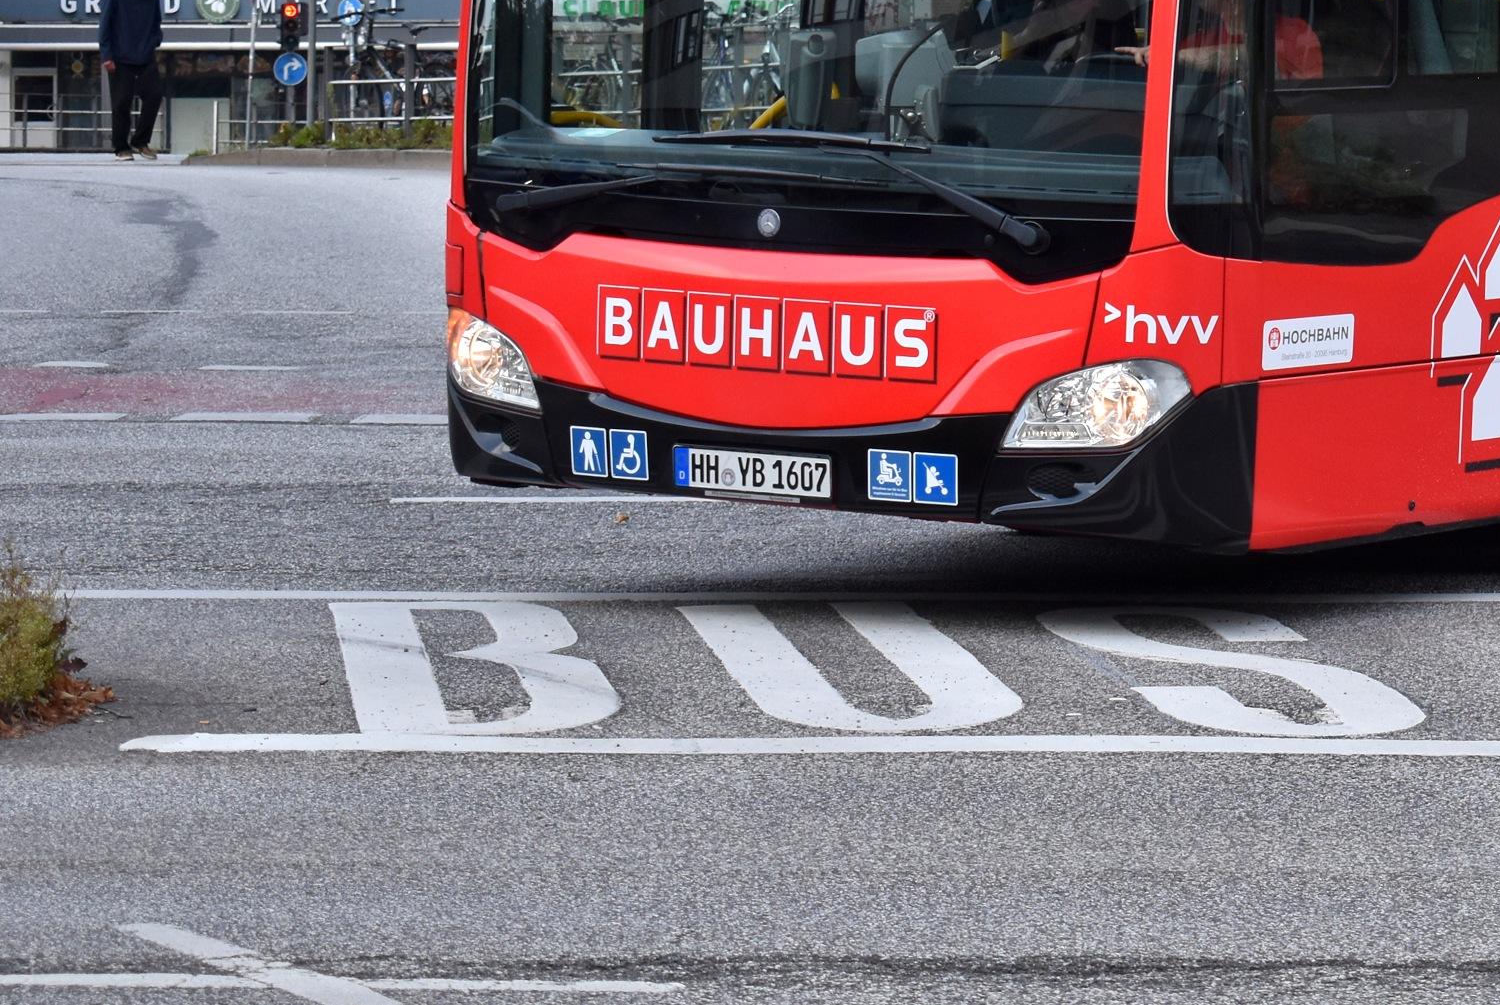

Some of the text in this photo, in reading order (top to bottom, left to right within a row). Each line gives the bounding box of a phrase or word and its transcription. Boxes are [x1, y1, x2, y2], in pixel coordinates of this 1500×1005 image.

[1282, 326, 1349, 345] HOCHBAHN
[691, 453, 828, 493] HH YB 1607
[331, 599, 1427, 736] BUS
